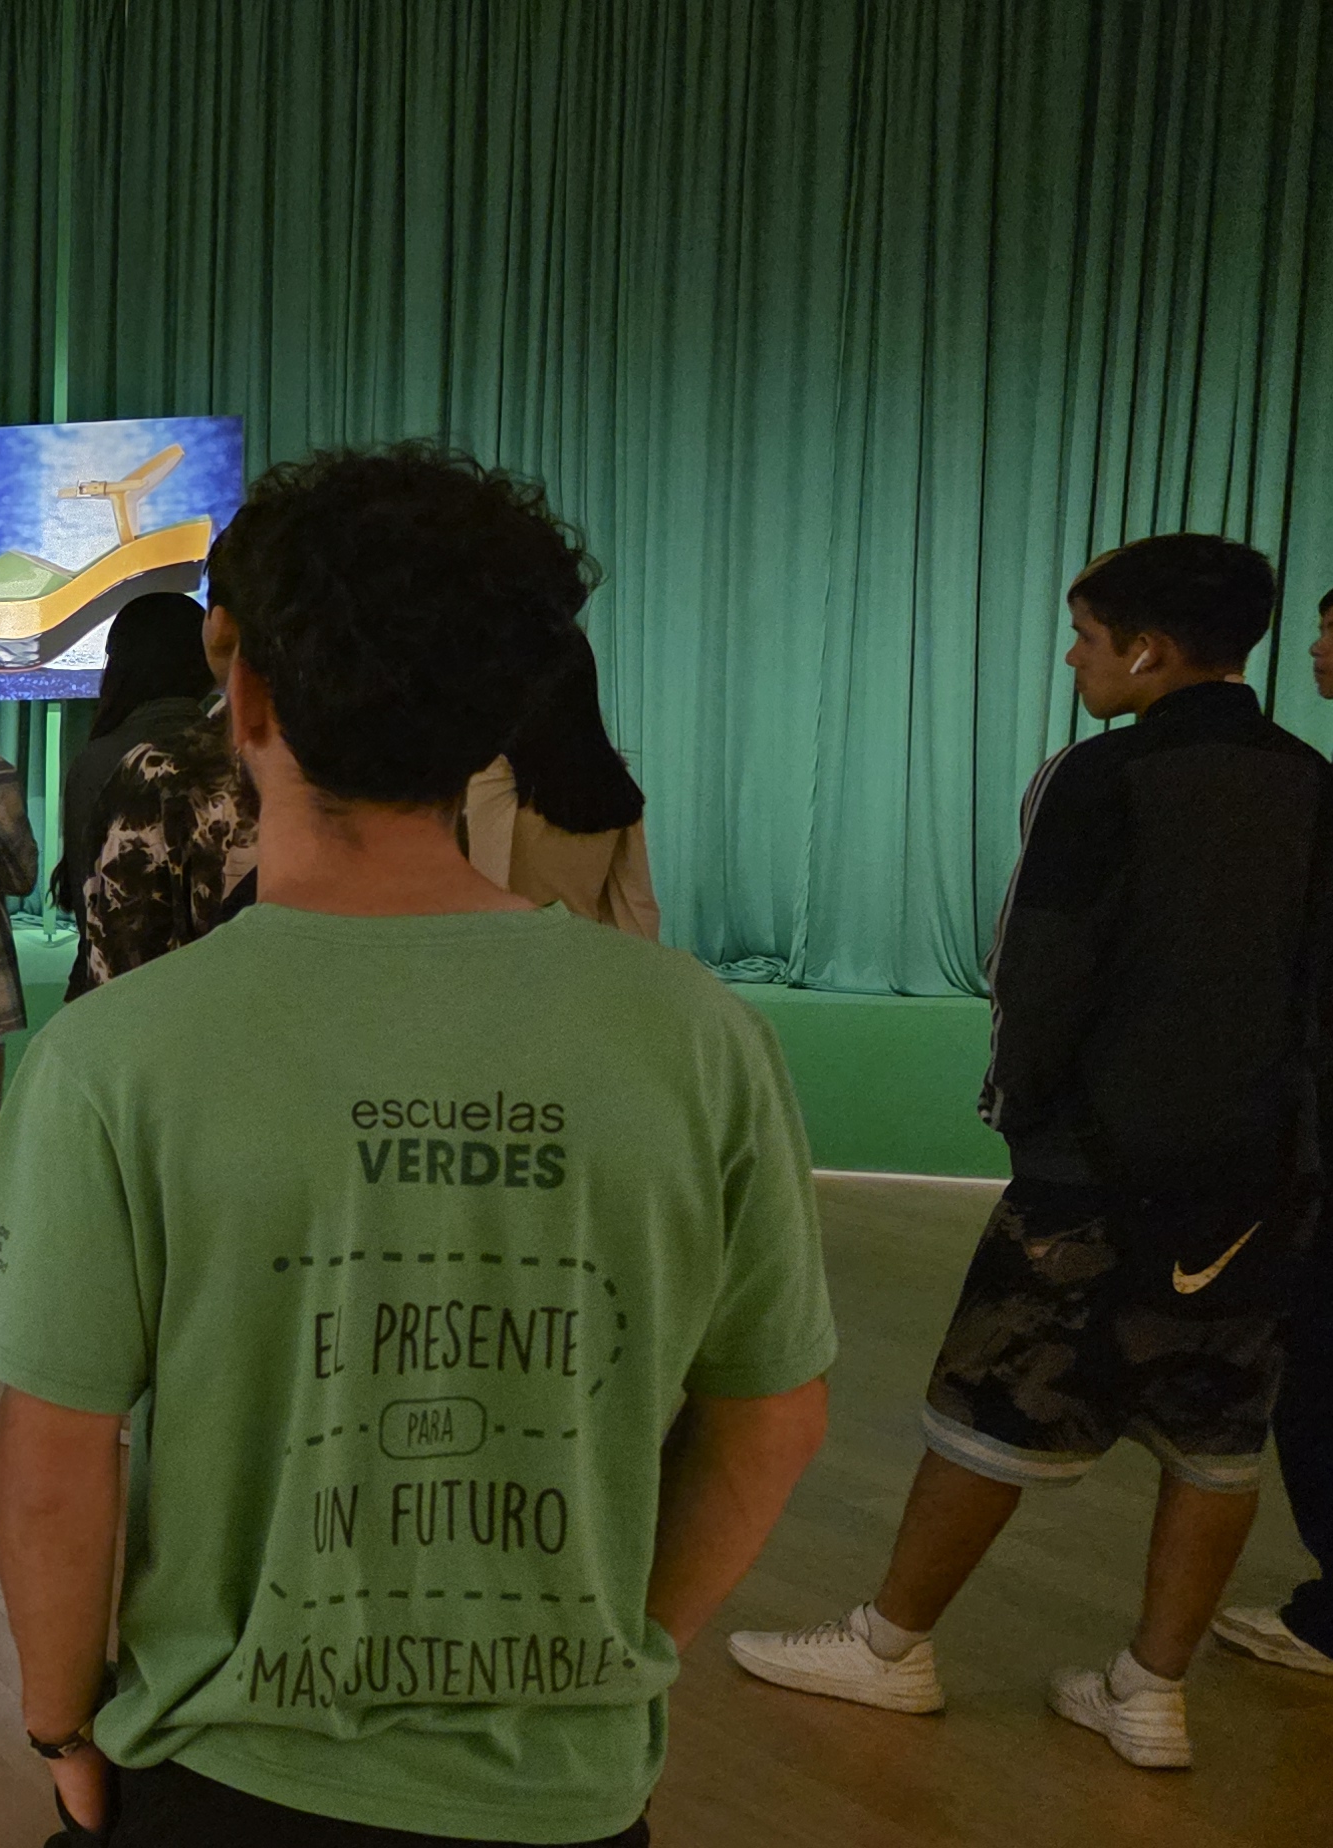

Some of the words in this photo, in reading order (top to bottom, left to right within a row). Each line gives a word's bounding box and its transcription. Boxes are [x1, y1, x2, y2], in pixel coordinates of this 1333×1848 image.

[351, 1091, 565, 1133] escuelas
[357, 1138, 567, 1190] VERDES
[315, 1305, 345, 1379] EL
[372, 1300, 579, 1376] PRESENTE
[407, 1407, 454, 1447] PARA
[314, 1484, 359, 1554] UN
[391, 1479, 568, 1555] FUTURO
[248, 1634, 339, 1709] MÁS
[343, 1634, 615, 1697] SUSTENTABLE
